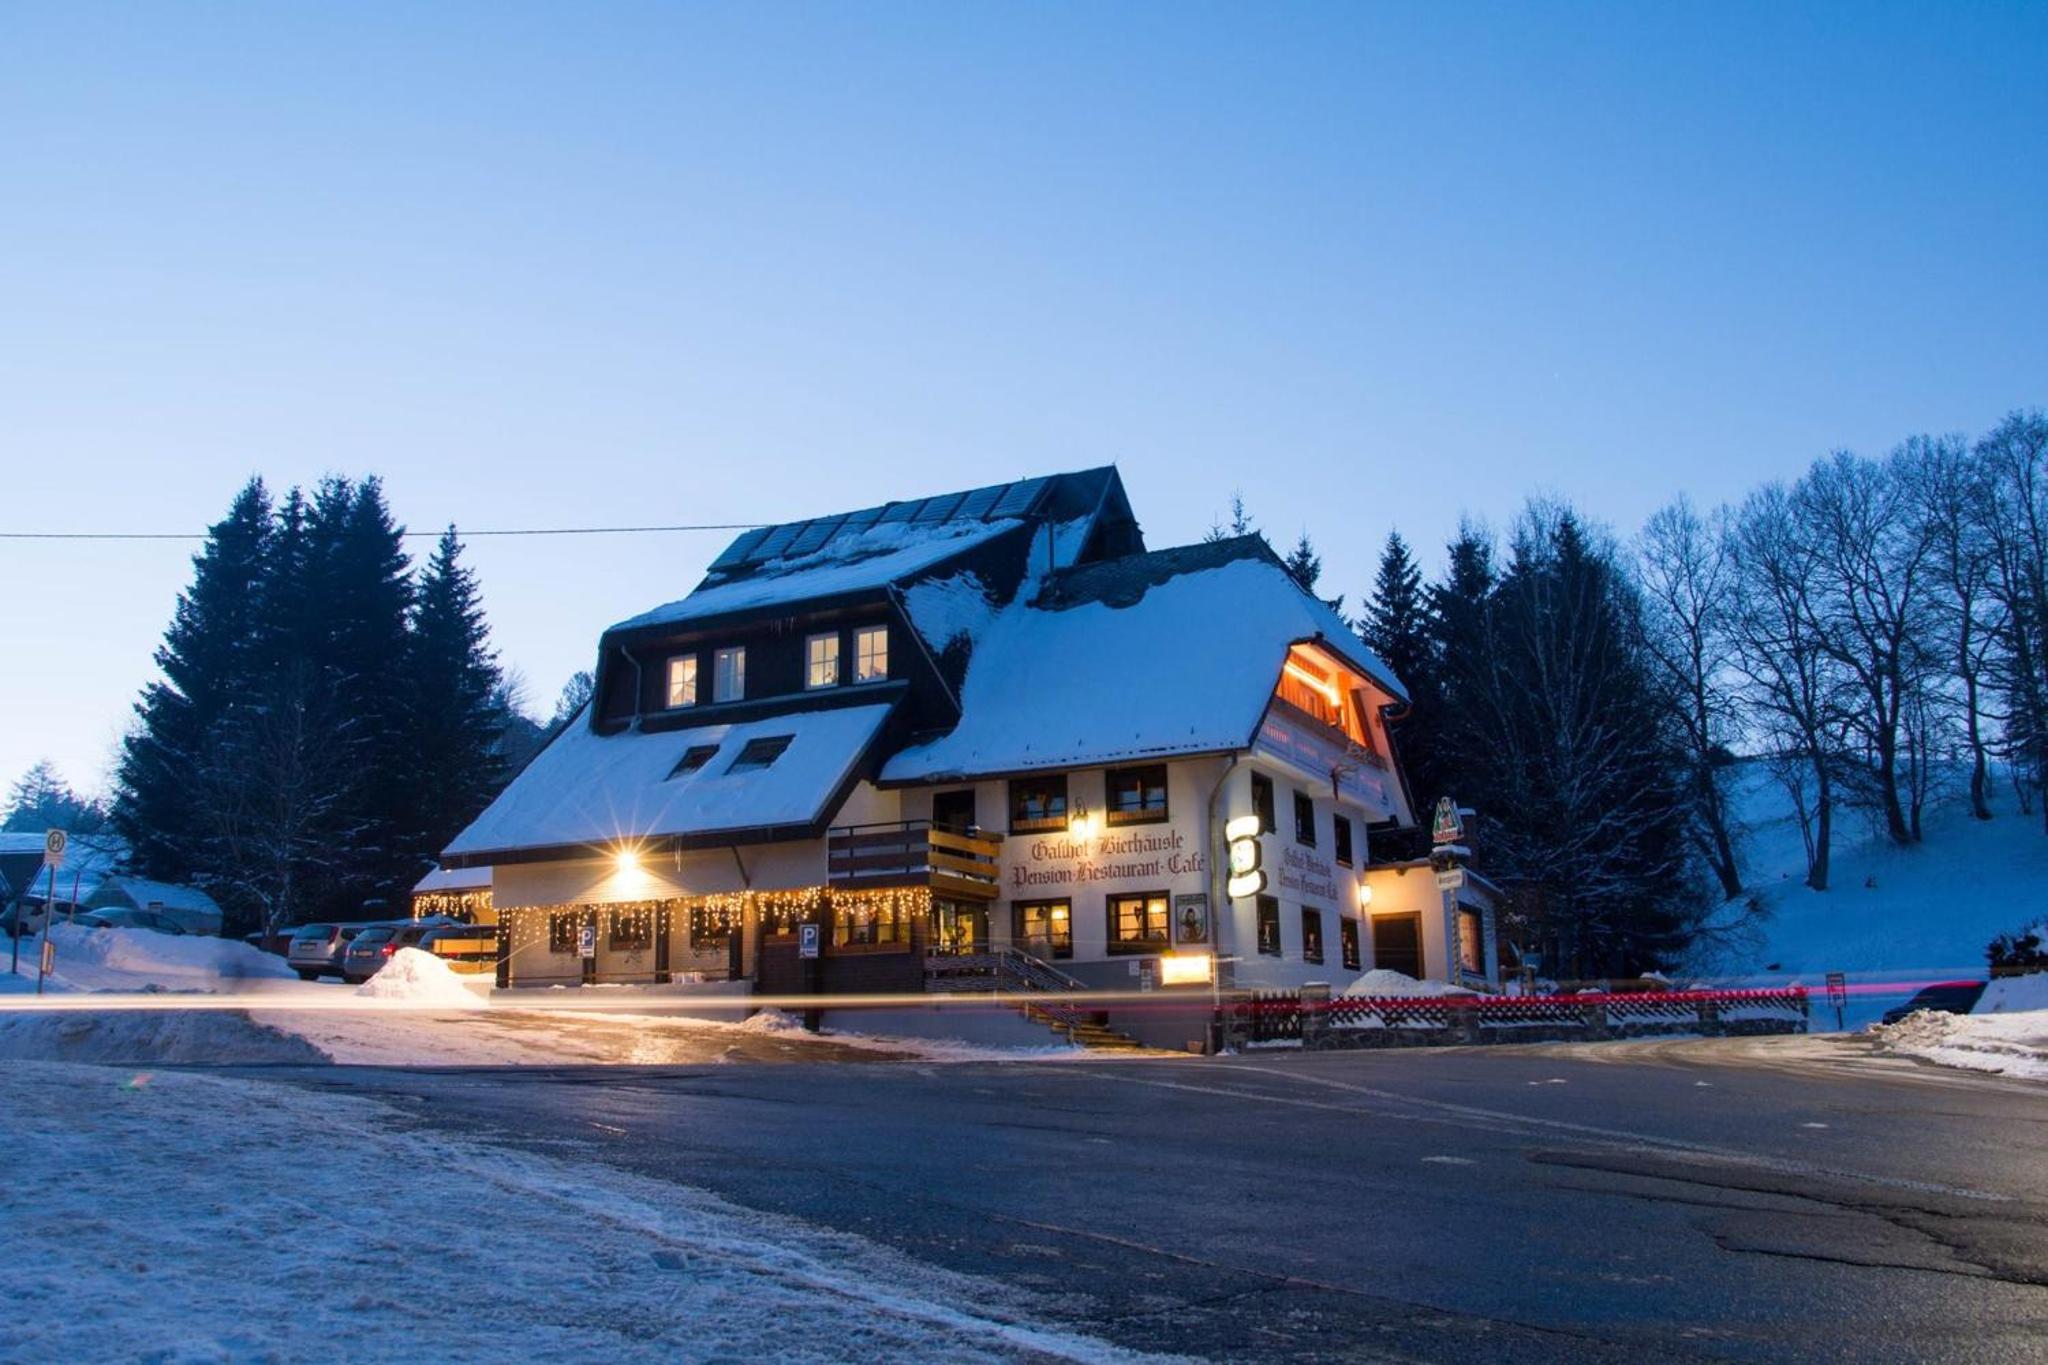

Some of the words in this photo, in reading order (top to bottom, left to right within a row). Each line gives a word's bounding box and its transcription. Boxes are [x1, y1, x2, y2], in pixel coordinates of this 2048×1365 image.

[1098, 829, 1184, 855] Bierhäusle
[1013, 866, 1072, 888] Pension
[1075, 858, 1160, 883] Restaurant
[582, 930, 592, 945] P
[803, 927, 815, 945] P
